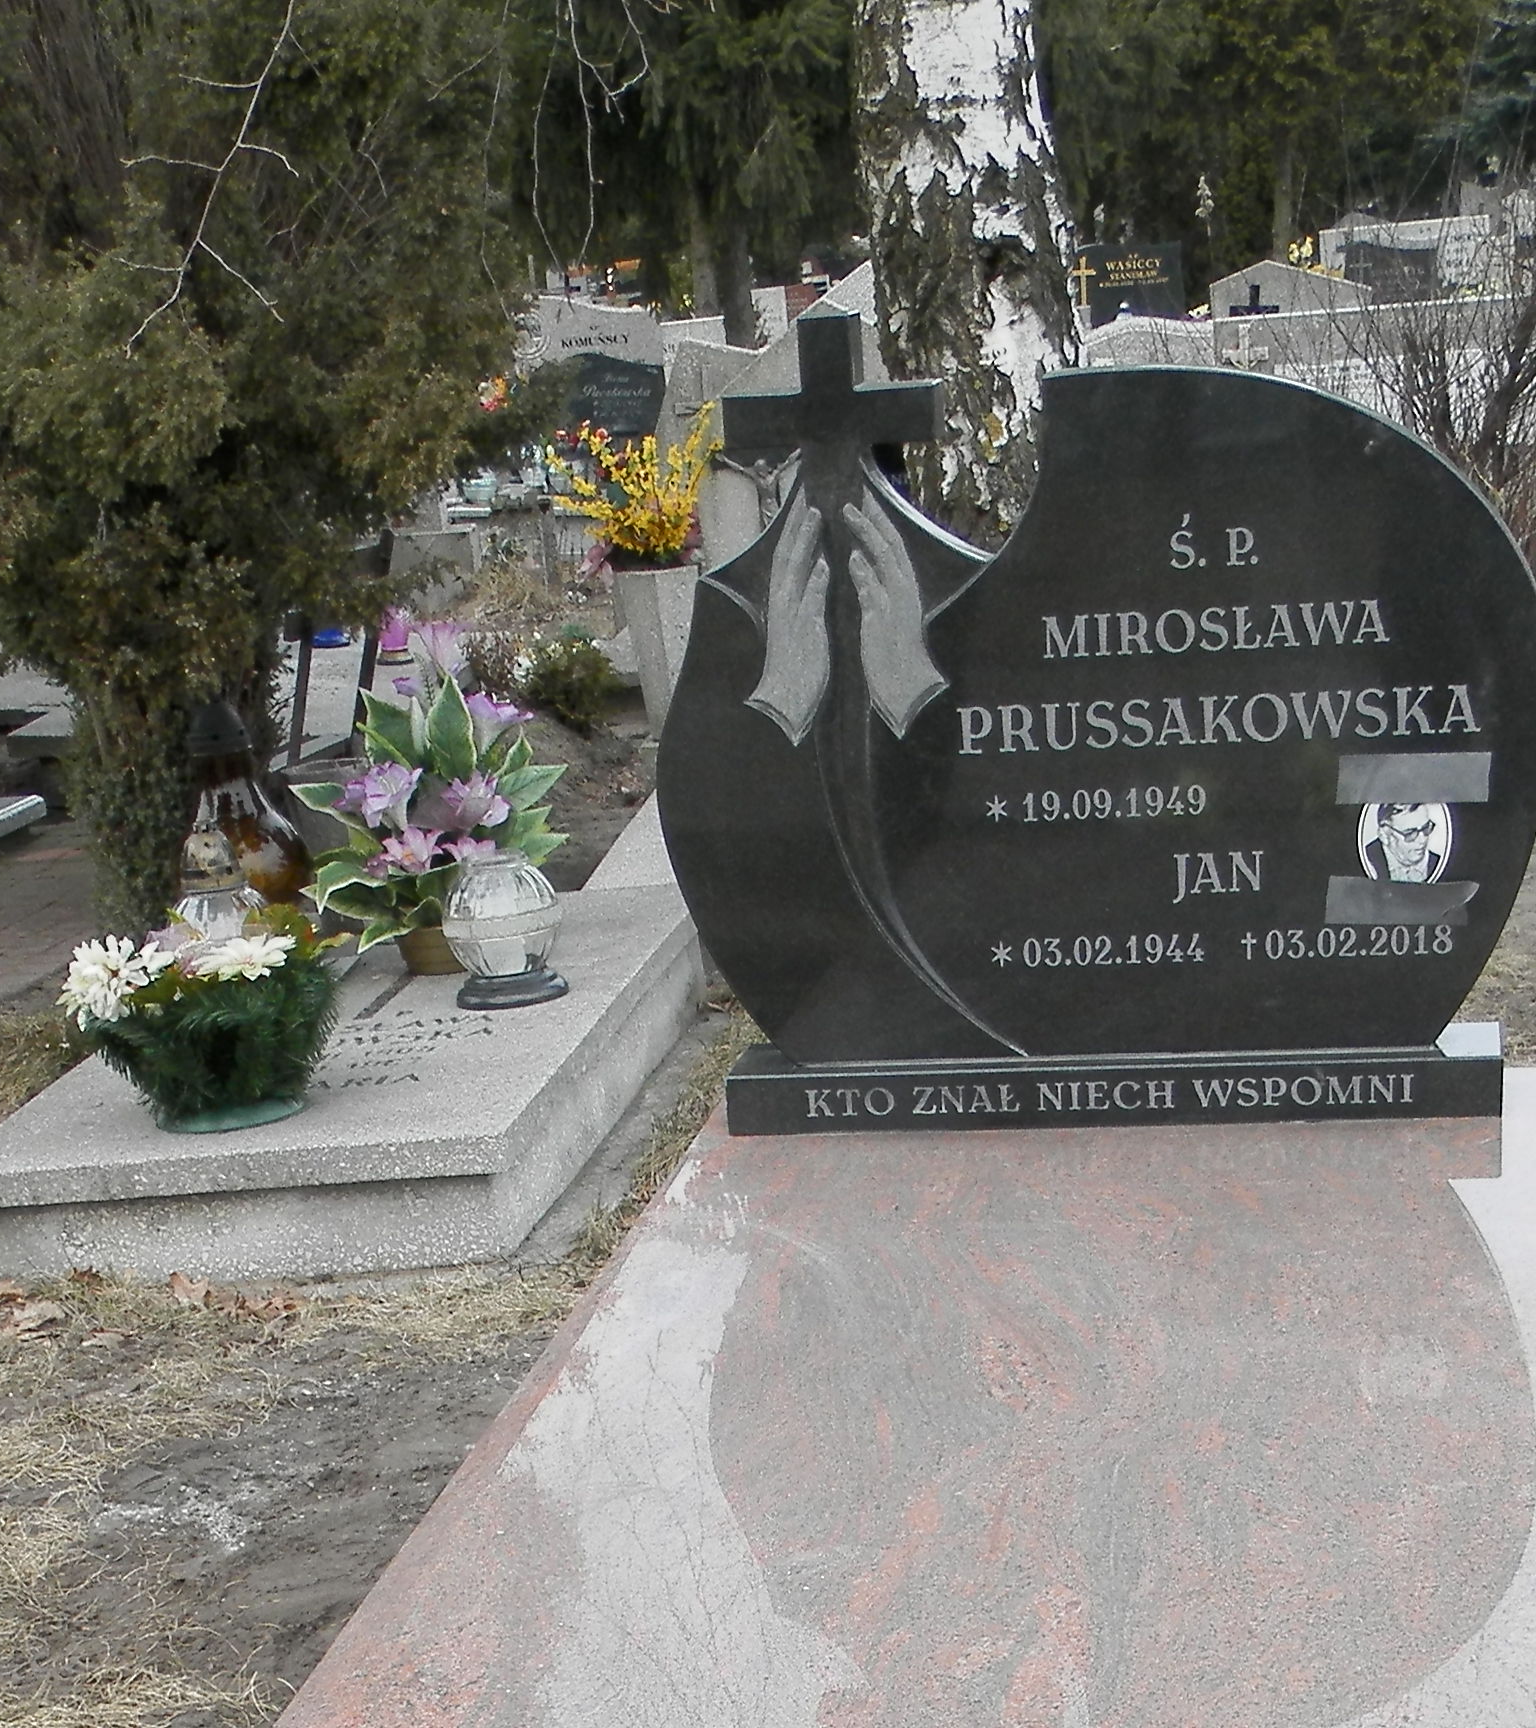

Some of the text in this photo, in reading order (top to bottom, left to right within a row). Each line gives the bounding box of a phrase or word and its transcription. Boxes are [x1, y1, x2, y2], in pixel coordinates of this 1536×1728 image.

[1170, 513, 1259, 570] Ś. P.
[1042, 600, 1390, 659] MIROSŁAWA
[957, 684, 1482, 756] PRUSSAKOWSKA
[1022, 784, 1207, 823] 19.09.1949
[1172, 850, 1265, 904] JAN
[1022, 924, 1455, 969] 03.02.1944 03.02.2018
[805, 1073, 1415, 1118] KTO ZNAŁ NIECH WSPOMNI
